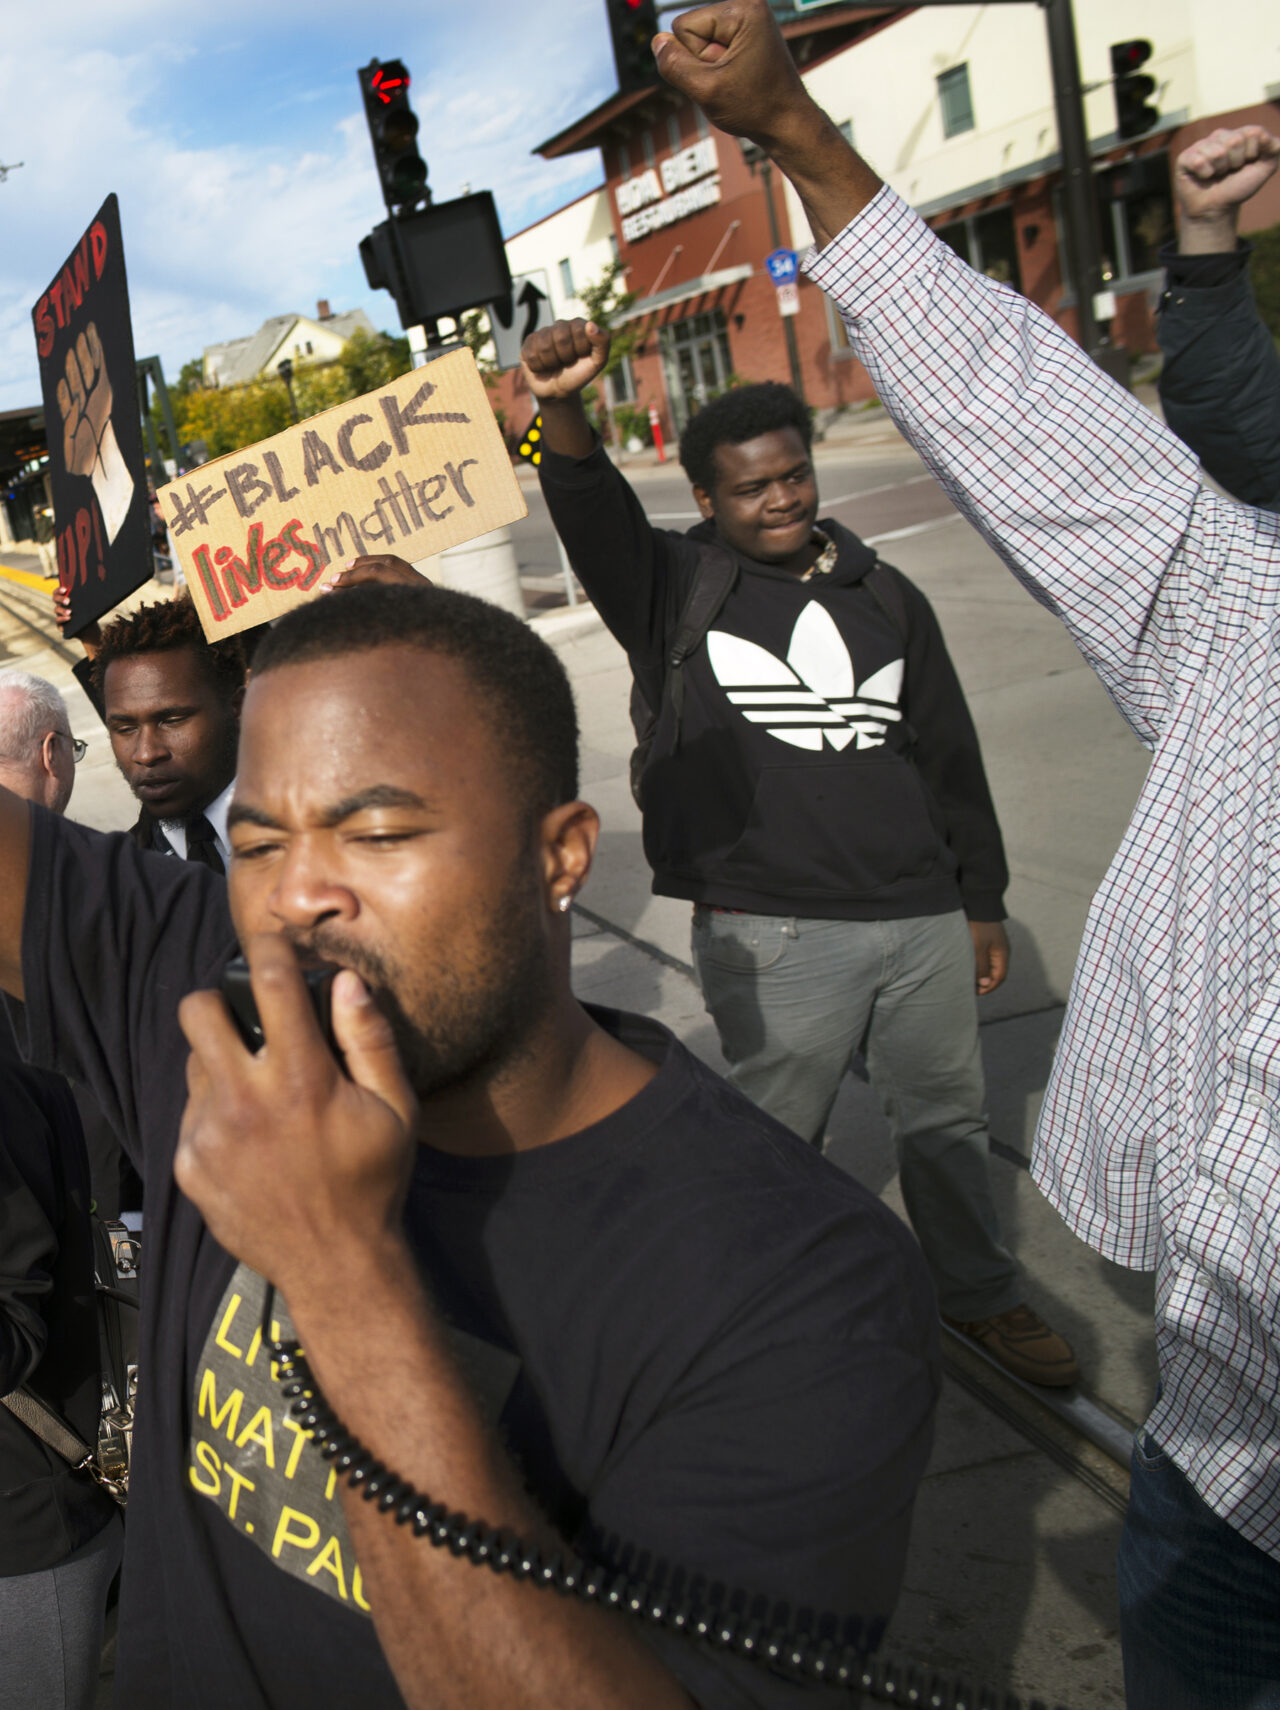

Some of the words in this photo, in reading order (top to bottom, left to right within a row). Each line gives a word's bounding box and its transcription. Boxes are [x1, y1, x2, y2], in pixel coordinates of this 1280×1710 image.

[33, 220, 108, 358] STAND
[170, 381, 470, 537] #BLACK
[56, 500, 107, 591] UP!
[189, 1440, 255, 1534] ST.
[272, 1505, 371, 1611] PAU
